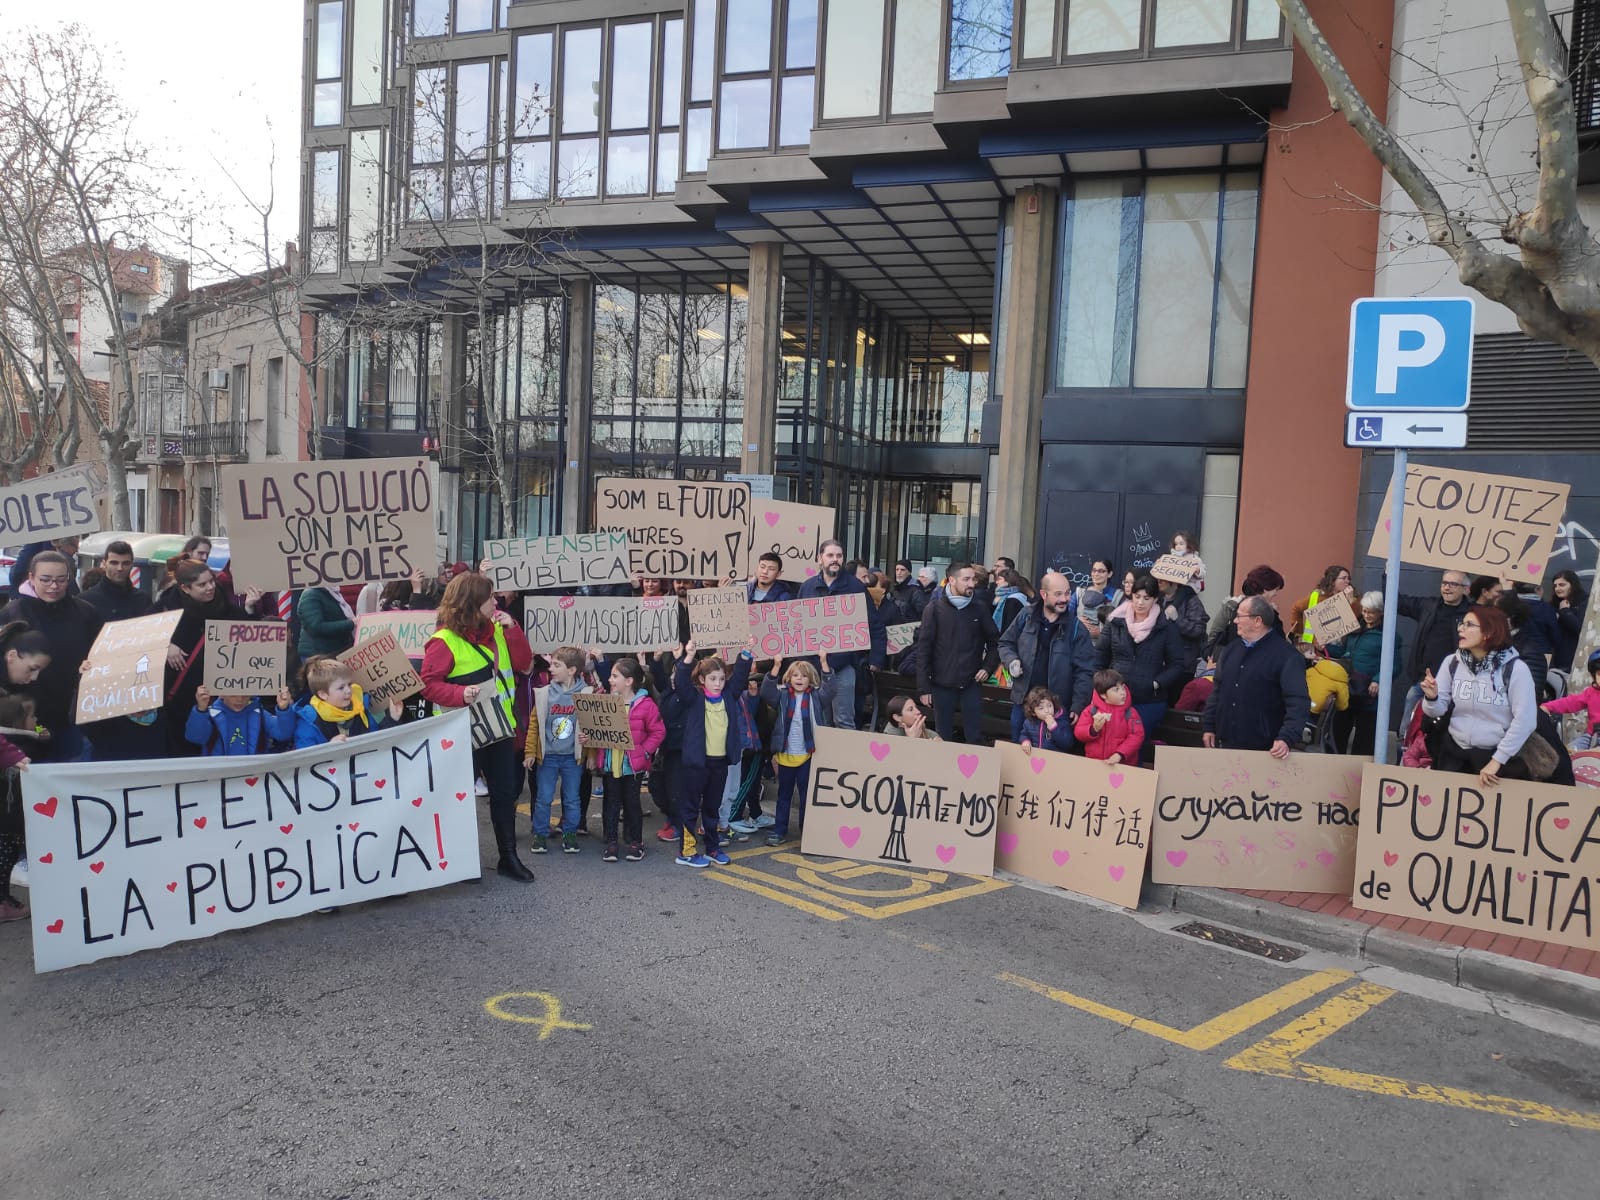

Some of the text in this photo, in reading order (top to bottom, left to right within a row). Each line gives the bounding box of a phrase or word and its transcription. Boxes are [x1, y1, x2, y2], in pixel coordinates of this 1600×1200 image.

[1376, 314, 1446, 394] P
[238, 459, 432, 520] LA SOLUCIÓ
[1404, 468, 1561, 527] ÉCOUTEZ
[604, 488, 645, 510] SOM
[658, 492, 675, 511] EL
[678, 485, 748, 526] FUTUR
[346, 508, 403, 546] MÉS
[489, 531, 628, 561] DEFENSEM
[542, 552, 571, 566] LA
[1409, 517, 1540, 571] NOUS!
[287, 544, 413, 588] ESCOLES
[644, 599, 664, 607] STOP
[688, 591, 745, 606] DEFENSEM
[711, 608, 723, 619] LA
[208, 623, 288, 643] EL PROJECTE
[526, 607, 566, 643] PROU
[768, 620, 804, 634] LES
[216, 641, 276, 669] SÍ QUE
[366, 660, 389, 682] LES
[582, 727, 630, 745] PROMESES
[592, 715, 612, 727] LES
[71, 738, 435, 861] DEFENSEM
[1360, 869, 1391, 901] de
[80, 877, 155, 945] LA
